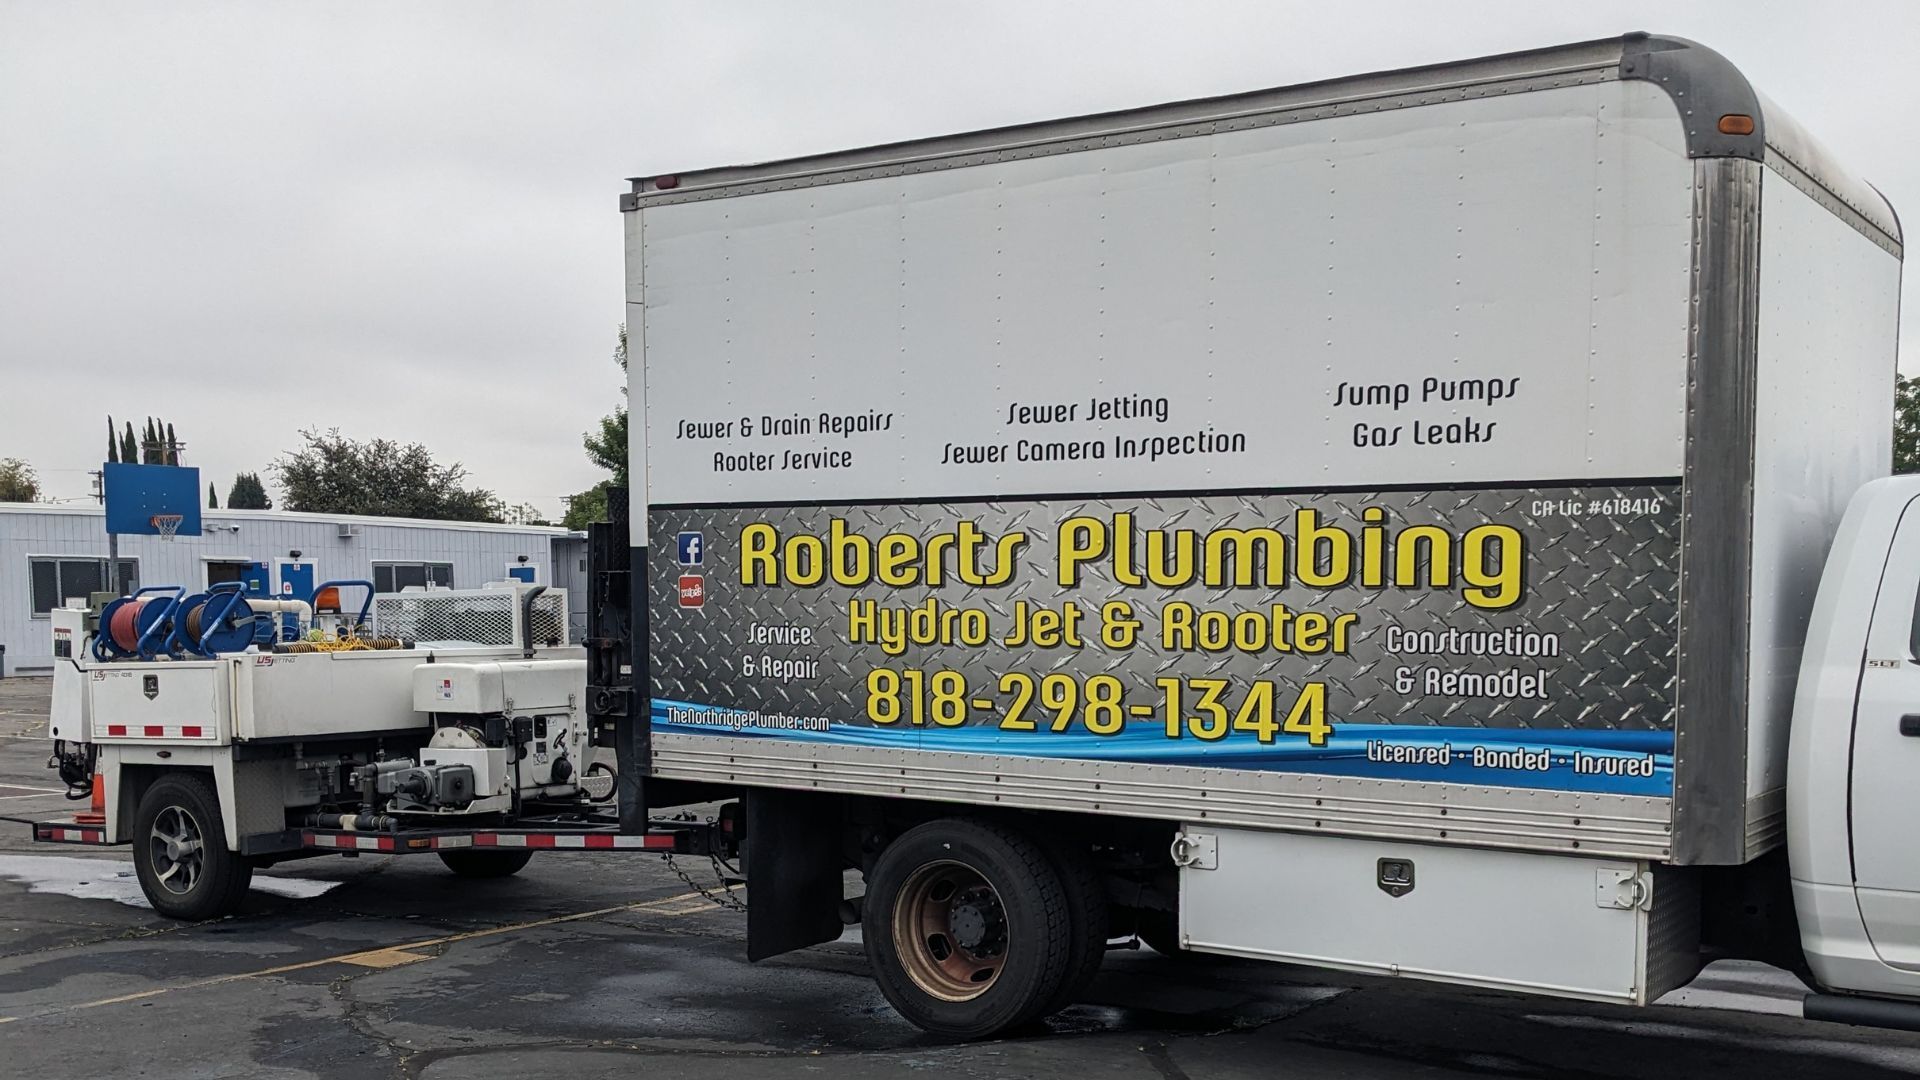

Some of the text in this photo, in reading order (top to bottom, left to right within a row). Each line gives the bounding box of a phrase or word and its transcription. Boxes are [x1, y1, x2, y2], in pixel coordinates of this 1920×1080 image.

[1333, 377, 1521, 411] Sump Pumps
[676, 412, 894, 440] Sewer & Drain Repairs
[1006, 396, 1169, 425] Sewer Jetting
[941, 430, 1246, 465] Sewer Camera Inspection
[1353, 416, 1497, 448] Gas Leaks
[713, 449, 852, 472] Rooter Service
[1532, 498, 1660, 517] CA Lic #618416
[740, 507, 1524, 609] Roberts Plumbing
[747, 622, 812, 645] Service
[849, 599, 1357, 655] Hydro Jet & Rooter
[1387, 626, 1560, 657] Construction
[742, 655, 819, 684] & Repair
[1395, 666, 1549, 699] & Remodel
[667, 707, 830, 731] TheNorthridgePlumber.com
[866, 668, 1332, 745] 818-298-1344
[1367, 741, 1654, 777] Licensed Bonded Insured
